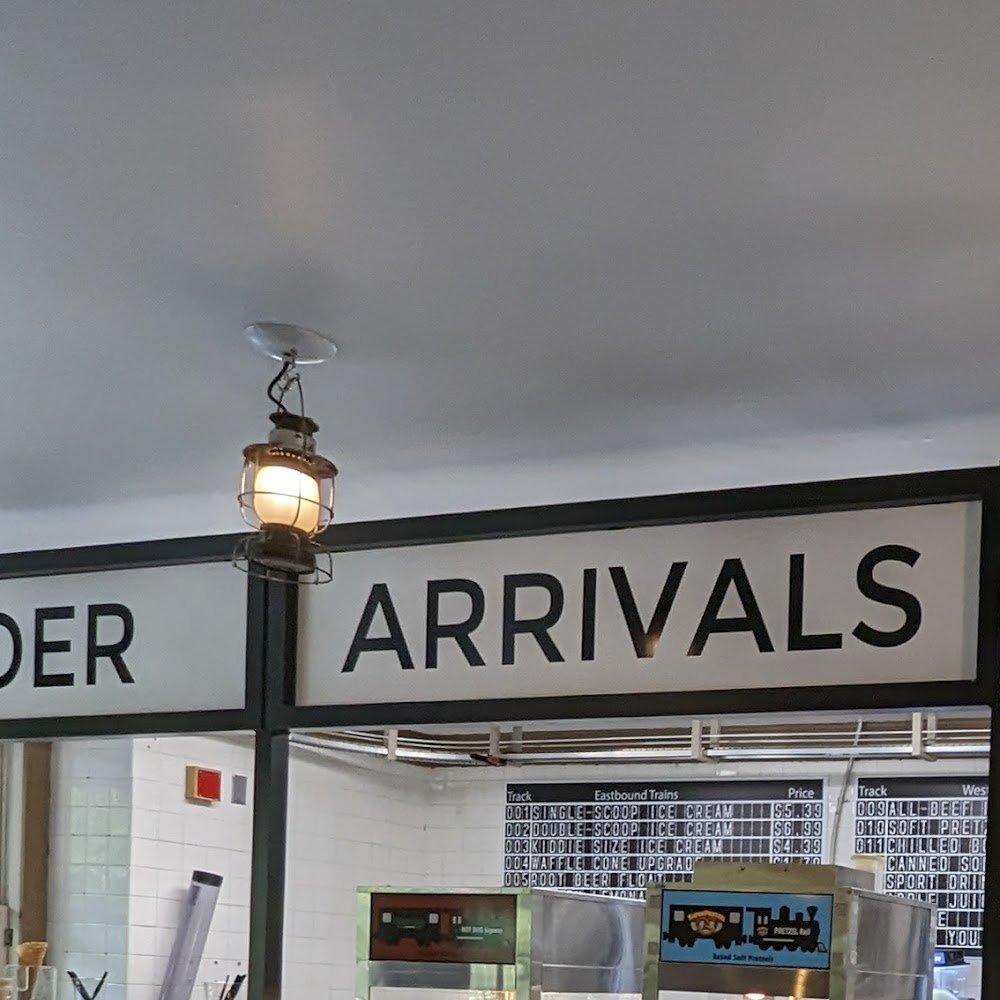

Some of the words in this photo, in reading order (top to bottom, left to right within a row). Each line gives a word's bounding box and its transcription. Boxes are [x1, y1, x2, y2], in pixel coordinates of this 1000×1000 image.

[341, 544, 922, 672] ARRIVALS
[507, 791, 532, 802] Track
[595, 789, 647, 801] Eastbound
[649, 789, 679, 800] Trains
[788, 787, 815, 799] Price
[859, 785, 888, 797] Track
[507, 805, 530, 820] 001
[533, 805, 638, 820] SINGLE-SCOOP
[651, 805, 675, 820] ICE
[686, 804, 733, 819] CREAM
[857, 801, 885, 816] 009
[889, 801, 970, 816] ALL-BEEF
[506, 822, 530, 837] 002
[533, 822, 638, 837] DOUBLE-SCOOP
[651, 822, 675, 837] ICE
[686, 821, 733, 836] CREAM
[857, 820, 885, 835] 010
[889, 820, 927, 835] SOFT
[506, 839, 529, 853] 003
[532, 839, 583, 853] KIDDIE
[593, 839, 628, 853] SIZE
[640, 839, 664, 853] ICE
[676, 839, 722, 854] CREAM
[856, 838, 884, 853] 011
[888, 838, 958, 853] CHILLED
[506, 856, 529, 870] 004
[532, 856, 583, 870] WAFFLE
[593, 856, 628, 870] CONE
[639, 856, 702, 871] UPGRAD
[888, 857, 947, 872] CANNED
[505, 873, 529, 887] 005
[531, 873, 565, 887] ROOT
[574, 873, 609, 887] BEER
[886, 874, 936, 889] SPORT
[948, 930, 977, 945] YOU
